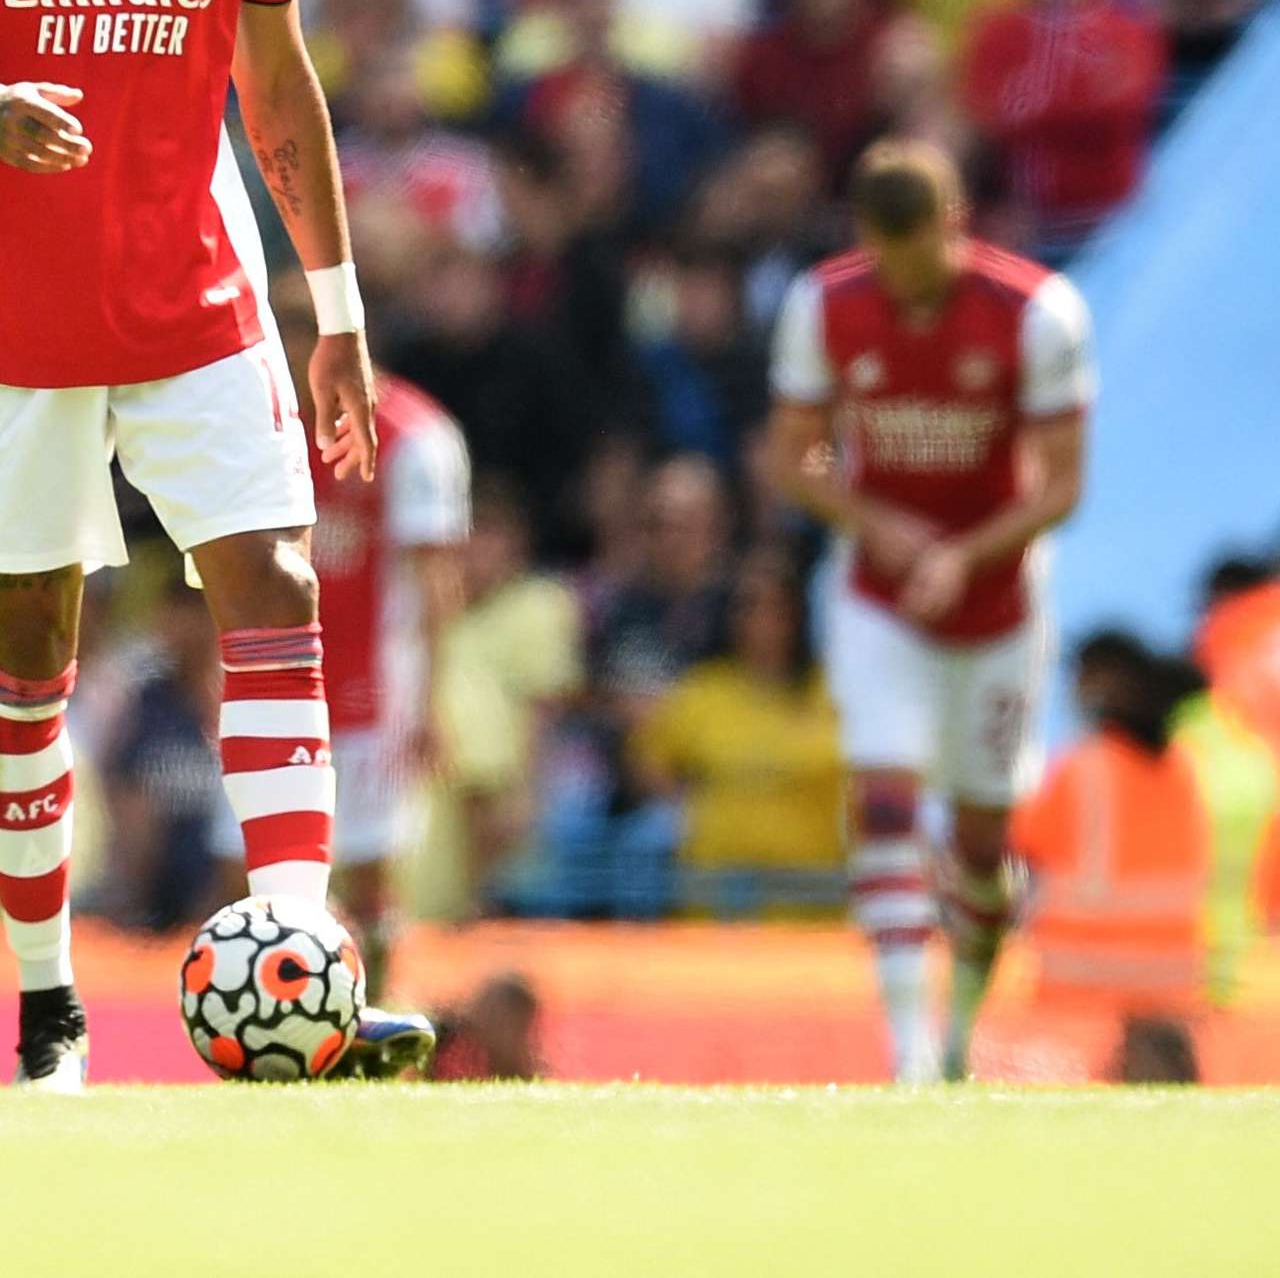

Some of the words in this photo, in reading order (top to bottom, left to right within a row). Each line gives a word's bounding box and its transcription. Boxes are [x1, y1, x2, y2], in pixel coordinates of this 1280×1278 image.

[37, 13, 86, 55] FLY
[93, 13, 188, 56] BETTER
[4, 792, 59, 821] AFC
